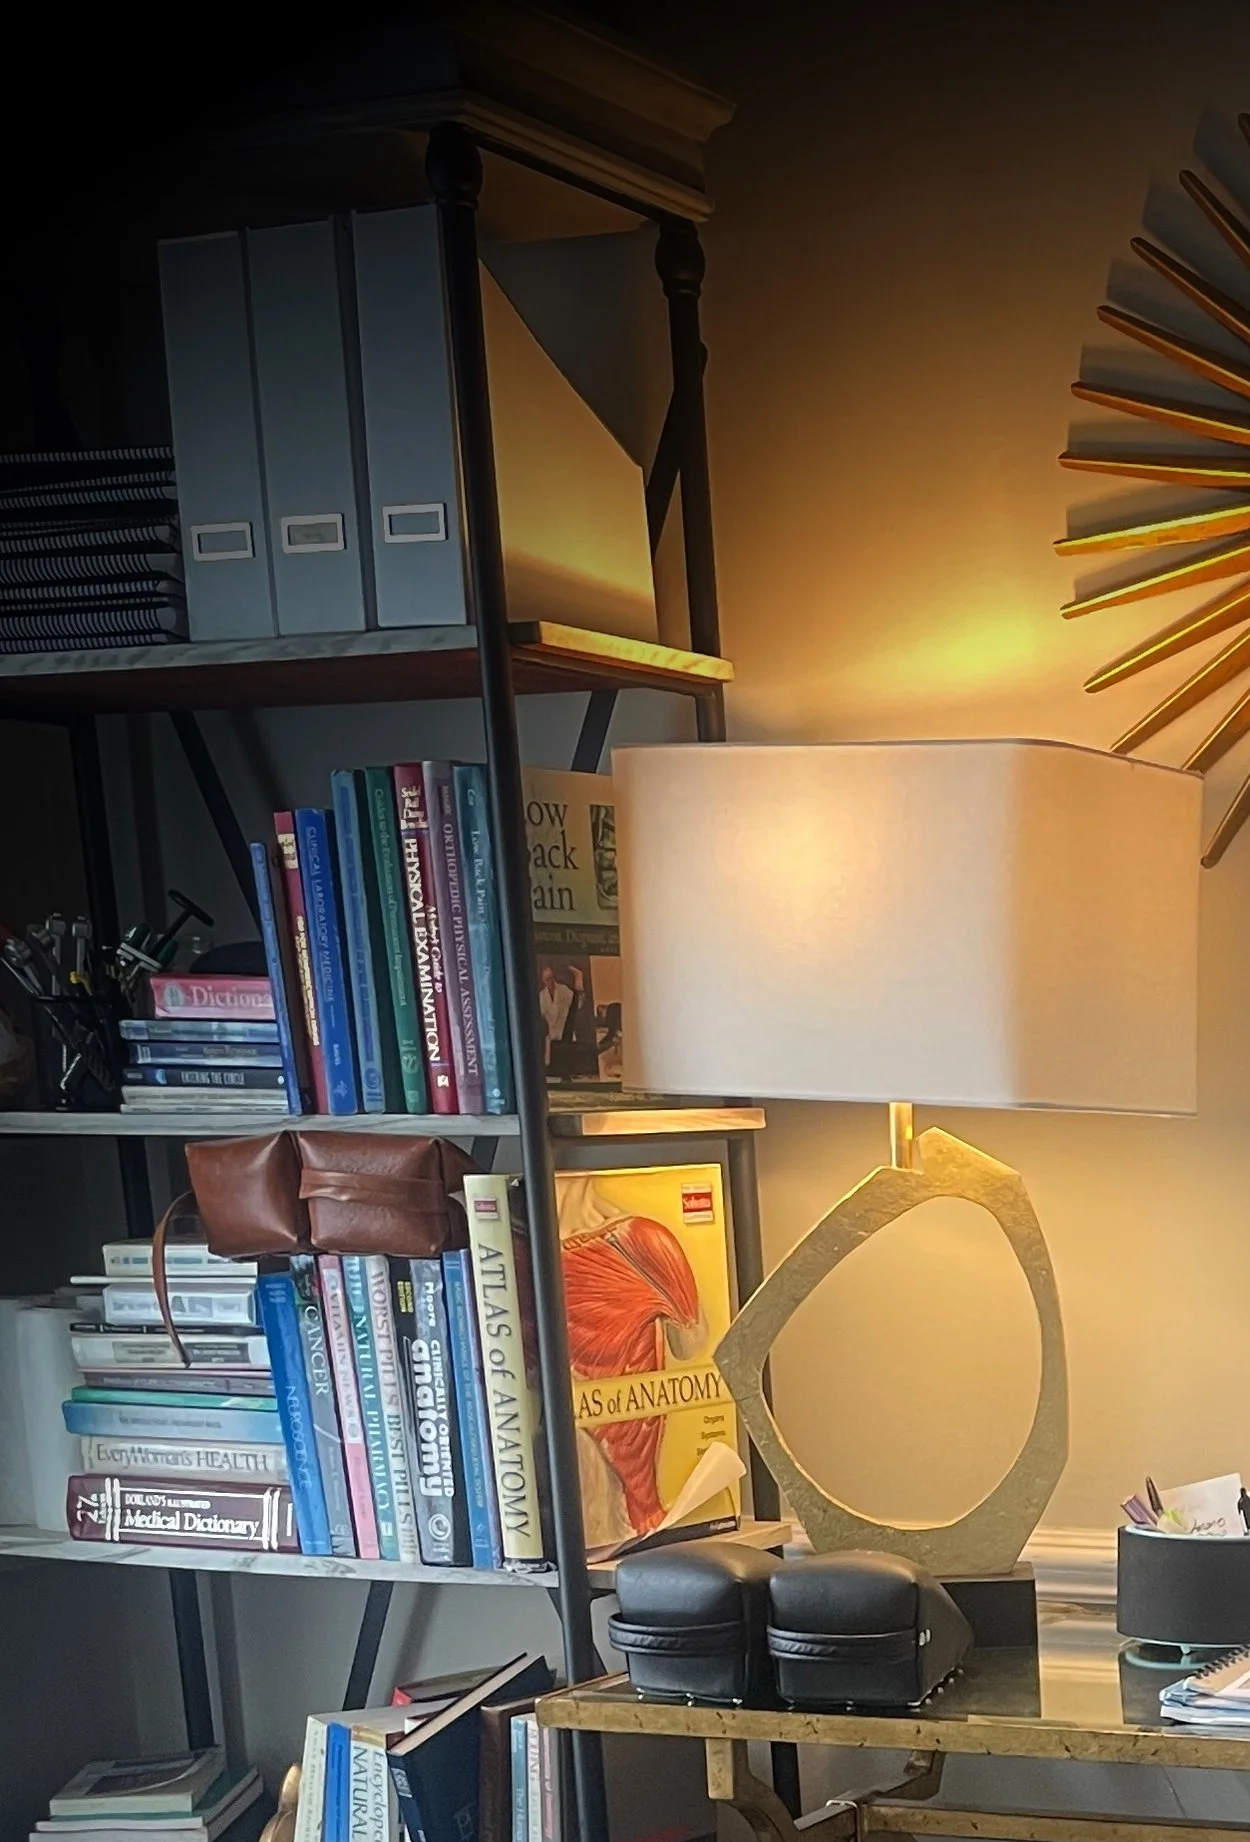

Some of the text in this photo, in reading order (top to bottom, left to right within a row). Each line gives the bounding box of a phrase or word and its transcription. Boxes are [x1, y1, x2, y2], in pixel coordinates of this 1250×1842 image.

[527, 801, 569, 828] ow
[534, 828, 579, 871] ack
[306, 827, 335, 1003] CLINICAL LABORATORY MEDICINE
[404, 838, 425, 924] PHYSICAL
[533, 874, 577, 912] ain
[414, 927, 440, 1061] EXAMINATION
[442, 823, 478, 1076] ORTHOPEDIC PHYSICAL ASSESSMENT
[423, 1281, 438, 1328] Moore
[478, 1243, 511, 1339] ATLAS
[305, 1305, 328, 1396] CANCER
[488, 1347, 515, 1381] of
[607, 1384, 622, 1414] of
[626, 1370, 723, 1411] ANATOMY
[355, 1316, 375, 1398] NATURAL
[367, 1410, 390, 1512] PHARMACY
[370, 1272, 412, 1525] WORST PILLS BEST PILLS
[409, 1339, 449, 1499] anatomy
[430, 1339, 456, 1497] CLINICALLY ORIENTED
[197, 1451, 268, 1472] HEALTH
[493, 1388, 530, 1539] ANATOMY
[125, 1510, 259, 1539] Medical Dictionary
[352, 1745, 369, 1840] NATURAL
